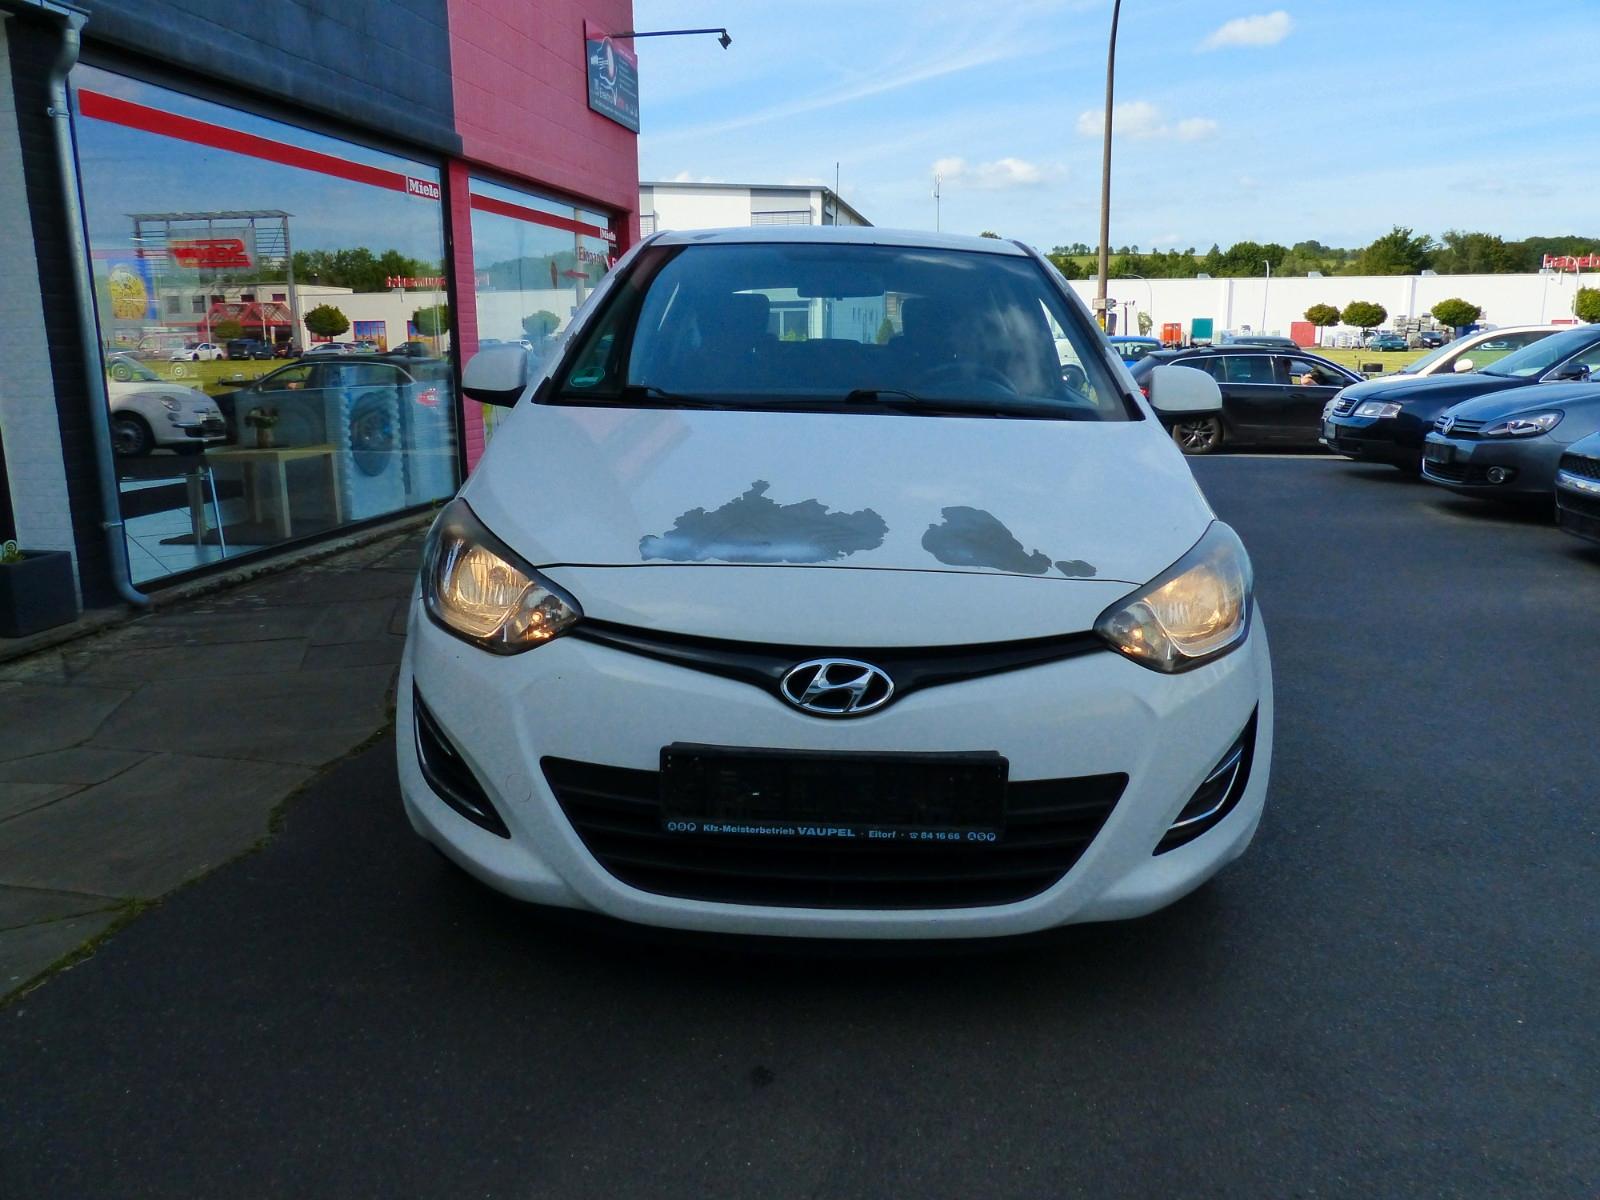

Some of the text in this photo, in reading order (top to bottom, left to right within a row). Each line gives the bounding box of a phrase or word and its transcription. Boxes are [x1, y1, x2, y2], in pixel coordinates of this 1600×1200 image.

[409, 179, 439, 197] Miele
[703, 824, 796, 835] Kfz-Meisterbetrieb
[797, 826, 856, 838] VAUPEL
[868, 829, 897, 839] Eitorf
